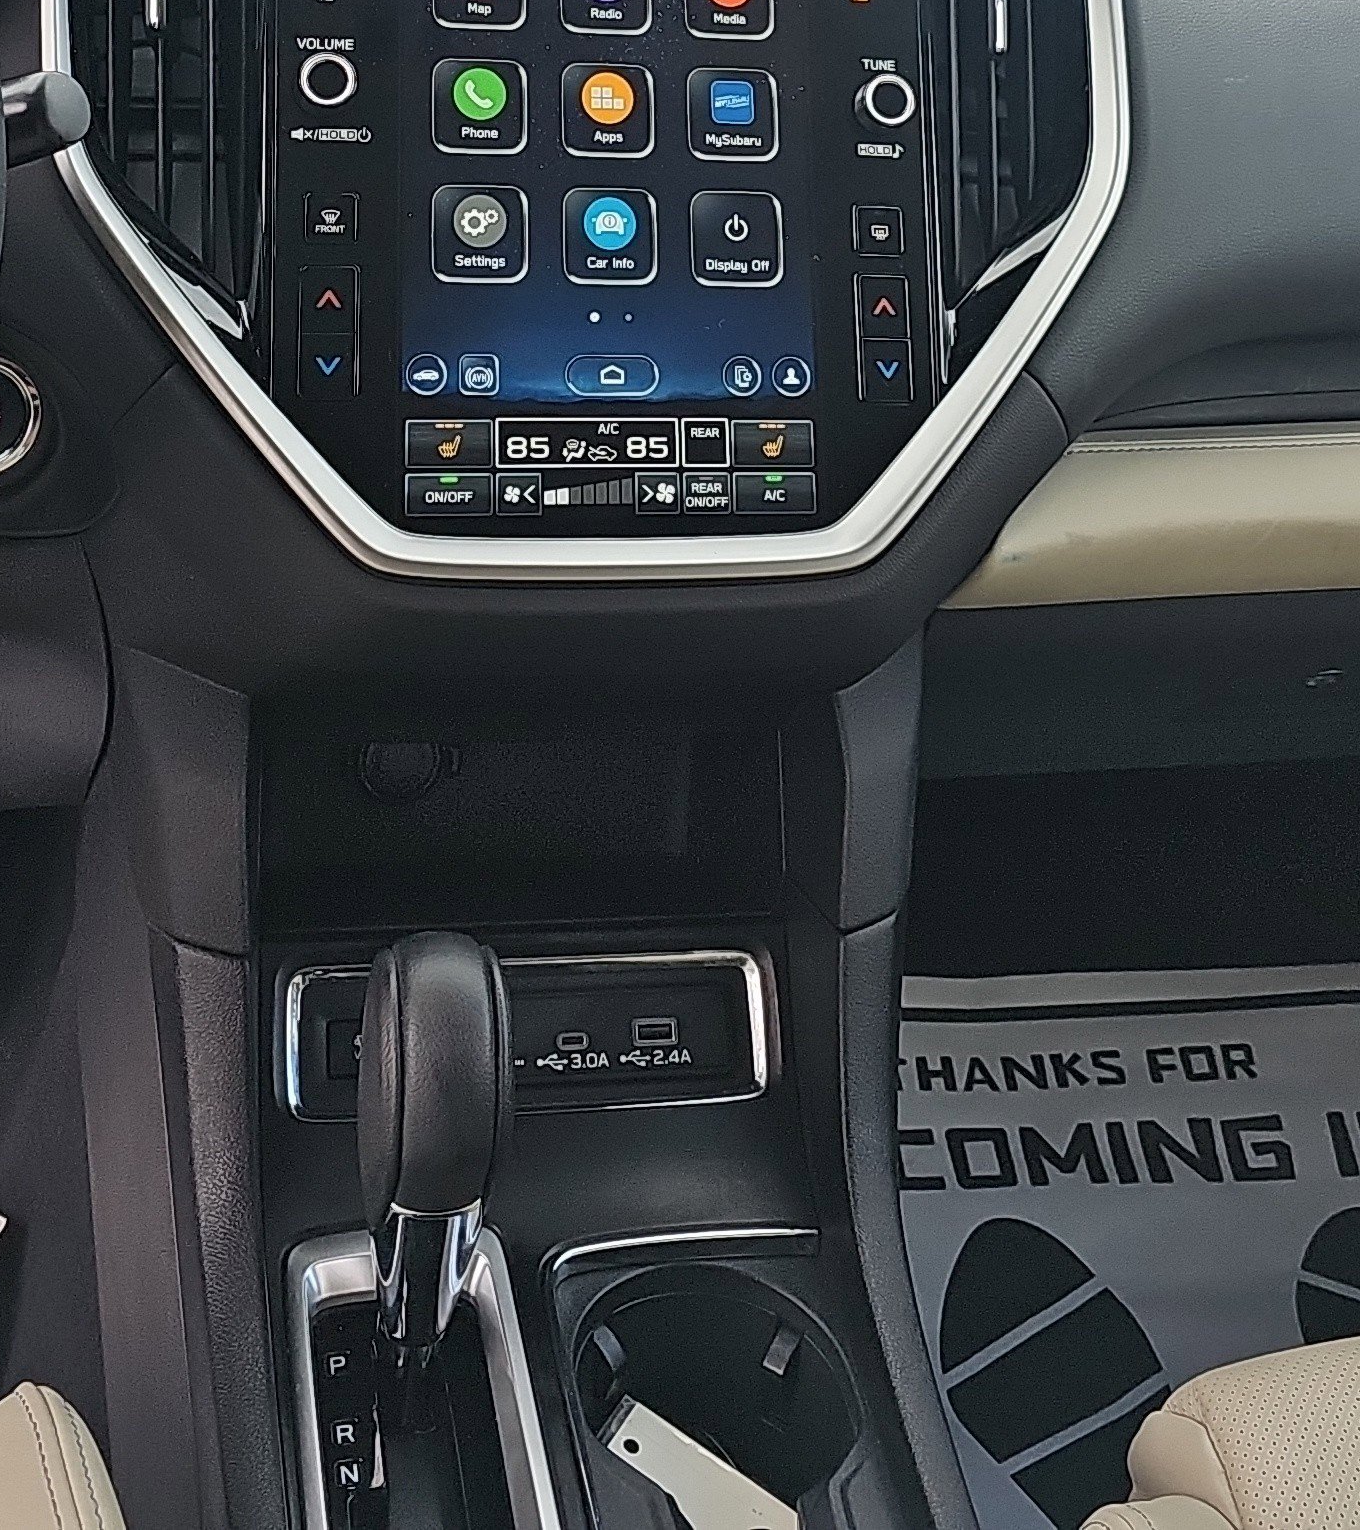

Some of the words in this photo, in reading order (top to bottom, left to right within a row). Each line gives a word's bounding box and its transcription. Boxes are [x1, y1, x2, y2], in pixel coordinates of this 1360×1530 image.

[467, 2, 492, 16] Map
[590, 8, 623, 20] Radio
[713, 13, 746, 25] Media
[296, 38, 355, 51] VOLUME
[861, 59, 896, 71] TUNE
[321, 129, 357, 140] HOLD
[461, 127, 499, 139] Phone
[593, 131, 624, 144] Apps
[705, 133, 762, 147] MySubaru
[858, 145, 892, 156] HOLD
[315, 224, 346, 234] FRONT
[455, 255, 506, 269] Settings
[587, 257, 608, 269] Car
[612, 257, 634, 269] Info
[705, 259, 748, 273] Display
[751, 260, 770, 271] Off
[471, 373, 487, 383] AVH
[597, 423, 620, 435] A/C
[690, 427, 720, 439] REAR
[506, 437, 550, 459] 85
[626, 437, 669, 459] 85
[691, 483, 723, 494] REAR
[425, 491, 474, 504] ON/OFF
[685, 496, 729, 508] ON/OFF
[764, 489, 786, 502] A/C
[570, 1052, 609, 1069] 3.0A
[652, 1049, 691, 1065] 2.4A
[1145, 1043, 1259, 1083] FOR
[897, 1113, 1296, 1191] COMING
[329, 1356, 346, 1375] P
[336, 1424, 356, 1444] R
[340, 1463, 359, 1484] N
